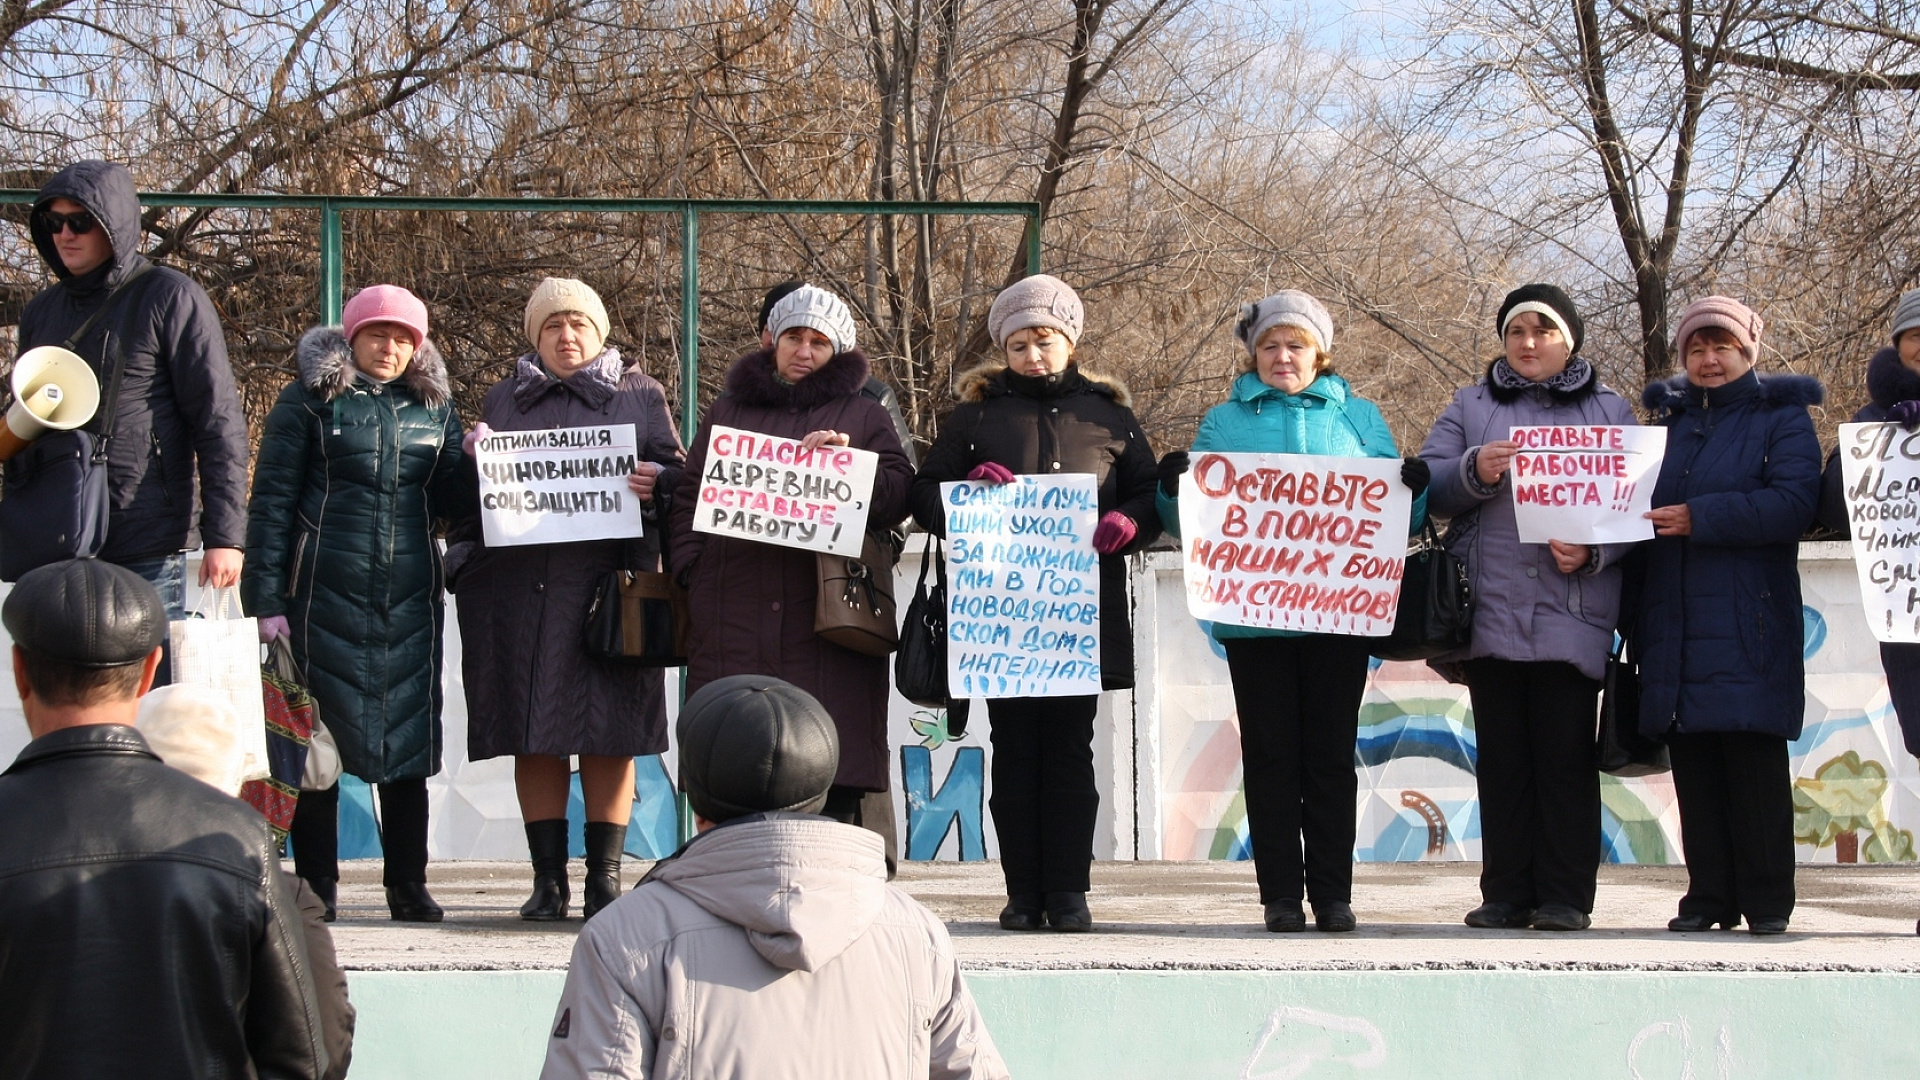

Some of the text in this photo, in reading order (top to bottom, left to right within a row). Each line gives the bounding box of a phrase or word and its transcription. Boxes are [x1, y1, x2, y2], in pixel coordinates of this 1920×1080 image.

[480, 430, 612, 452] ОПТИМИЗАЦИЯ
[1512, 427, 1624, 450] ОСТАВЬТЕ
[483, 455, 636, 485] ЧИНОВНИКАМ
[1515, 454, 1628, 478] РАБОЧИЕ
[705, 459, 863, 510] ДЕРЕВНЮ,
[950, 477, 1039, 509] САМЫЙ
[1516, 481, 1602, 507] МЕСТА
[483, 490, 622, 517] СОЦЗАЩИТЫ
[702, 486, 837, 526] ОСТАВЬТЕ
[948, 508, 1080, 543] ШИЙ УХОД
[1221, 503, 1383, 550] В ПОКОЕ
[1858, 525, 1920, 552] ЧАЙК
[951, 538, 984, 564] ЗА
[1190, 537, 1403, 581] НАШИХ БОЛЬ
[955, 568, 994, 591] МИ
[1006, 571, 1025, 591] В
[1869, 559, 1920, 593] См
[1246, 578, 1400, 624] СТАРИКОВ!
[949, 620, 1011, 647] СКОМ
